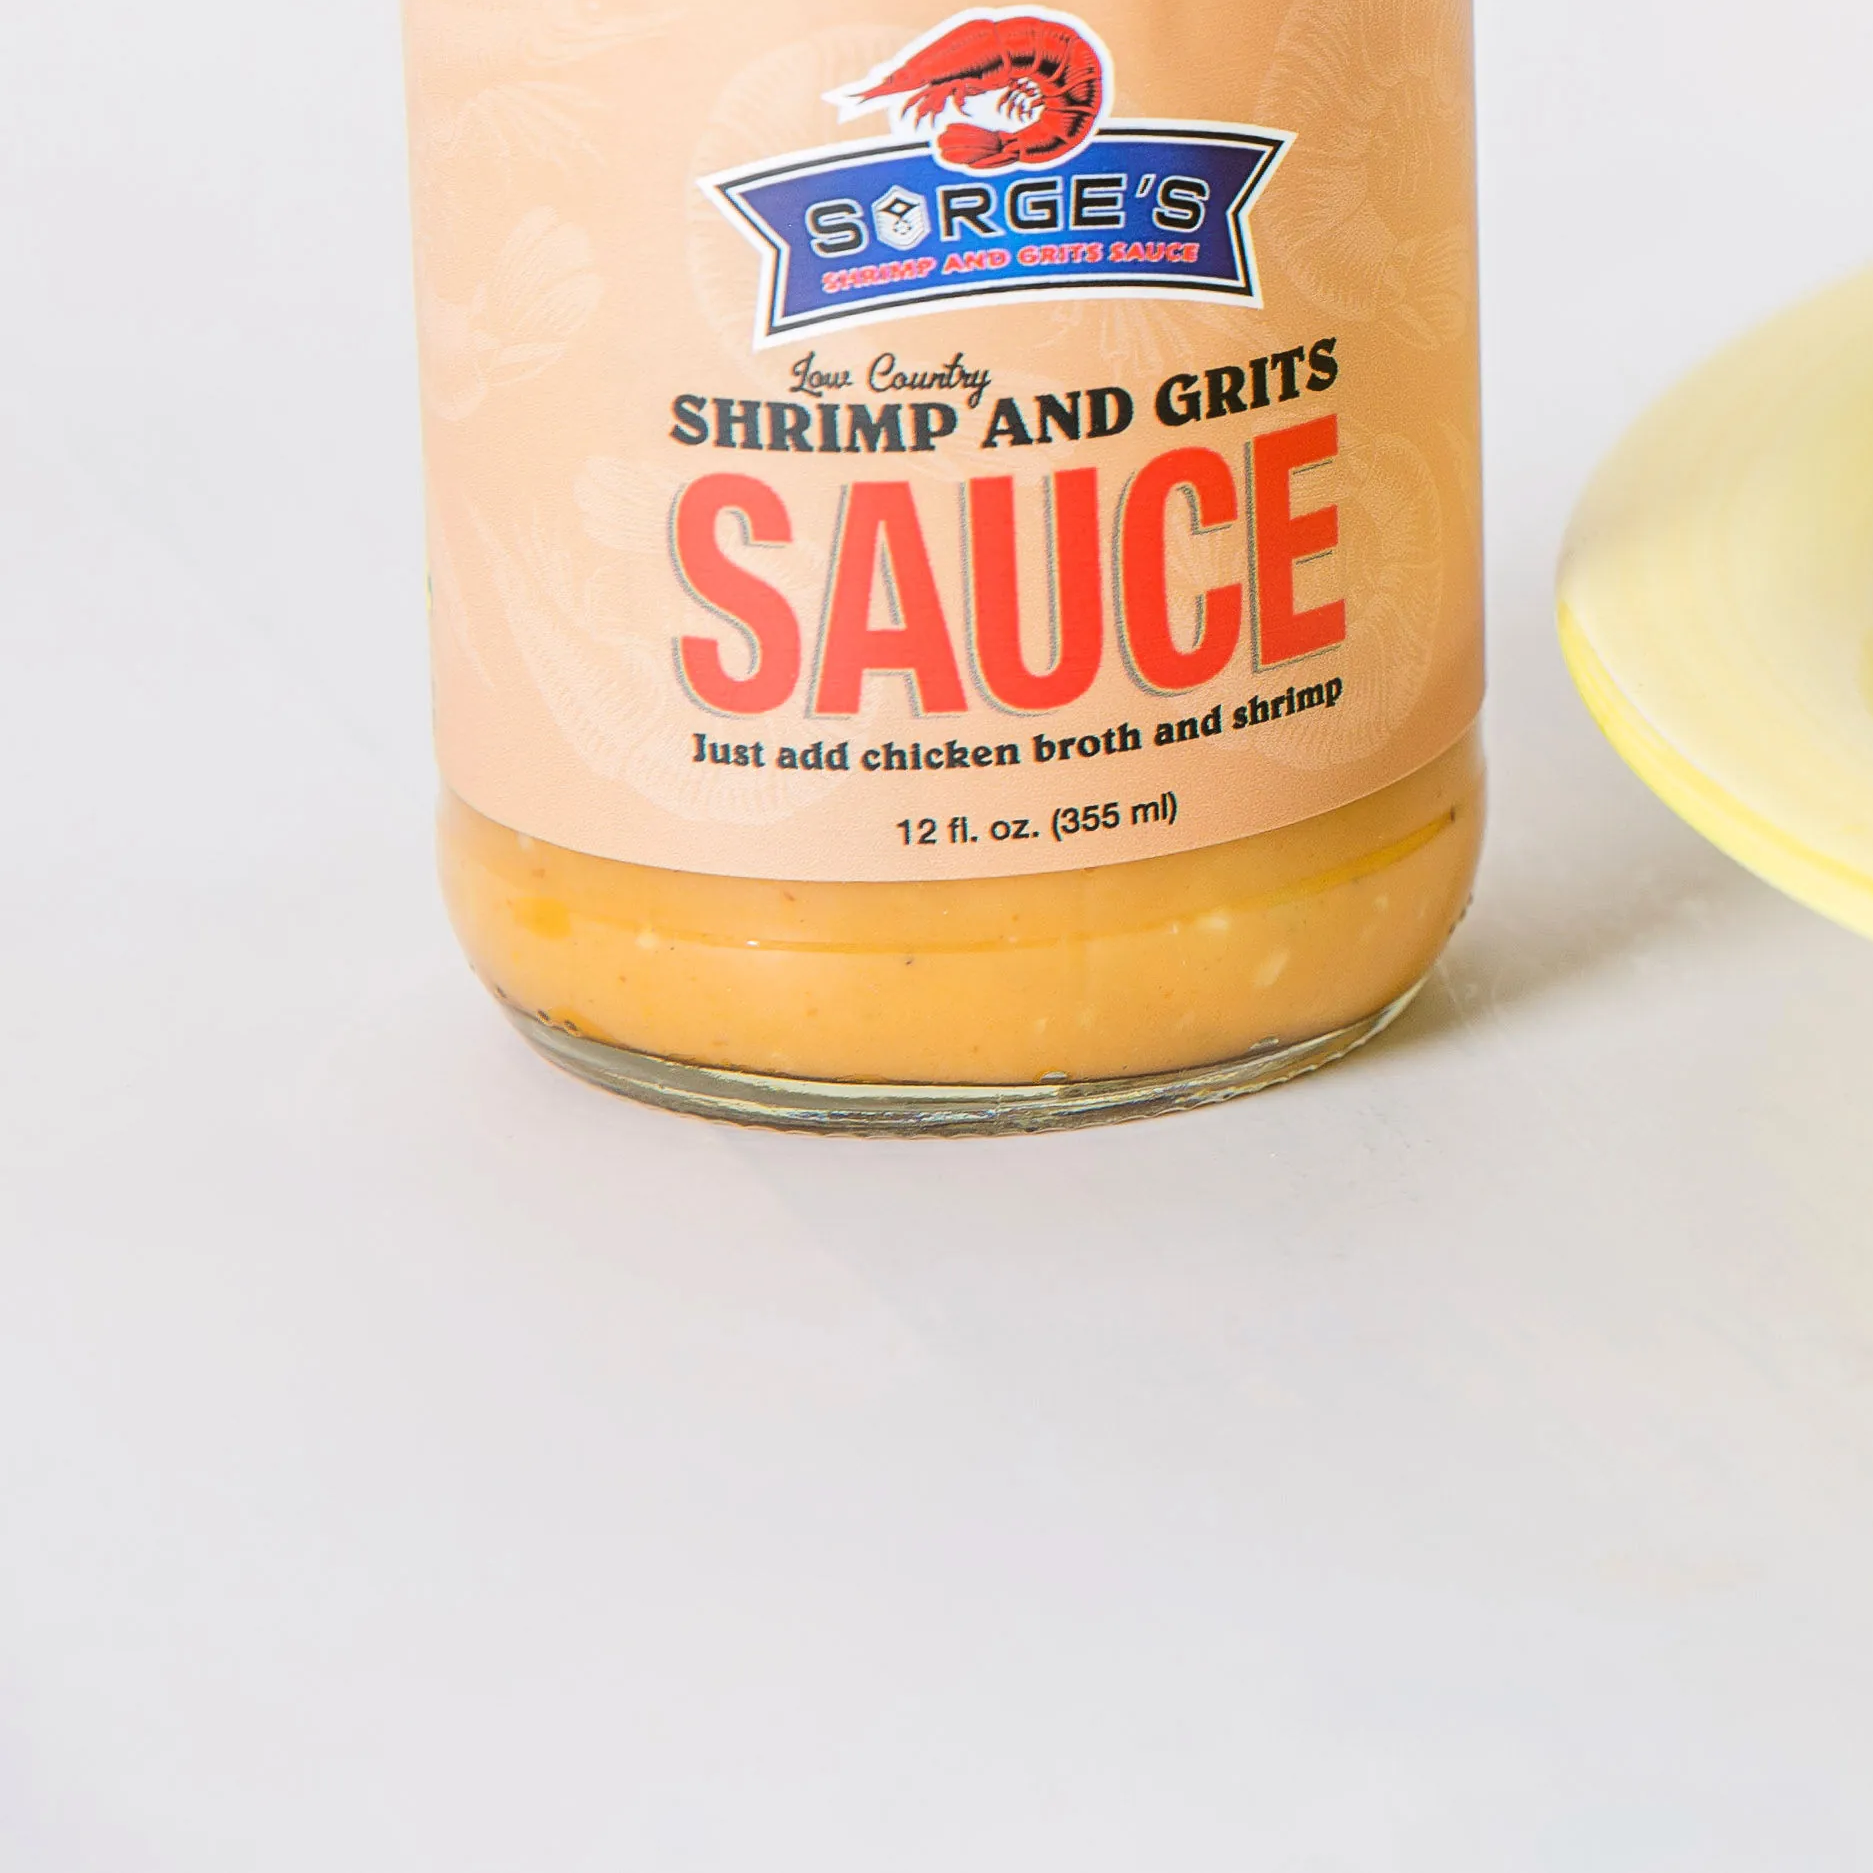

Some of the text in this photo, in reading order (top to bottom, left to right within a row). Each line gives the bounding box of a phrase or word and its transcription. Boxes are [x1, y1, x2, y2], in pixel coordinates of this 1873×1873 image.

[821, 240, 1200, 293] SHRIMP AND GRITS SAUCE
[669, 337, 1339, 452] SHRIMP AND GRITS
[788, 349, 991, 409] Low Country
[667, 413, 1347, 720] SAUCE
[692, 677, 1343, 772] Just add chicken broth and shrimp
[896, 791, 1179, 846] 12 fl. oz. (355 ml)
